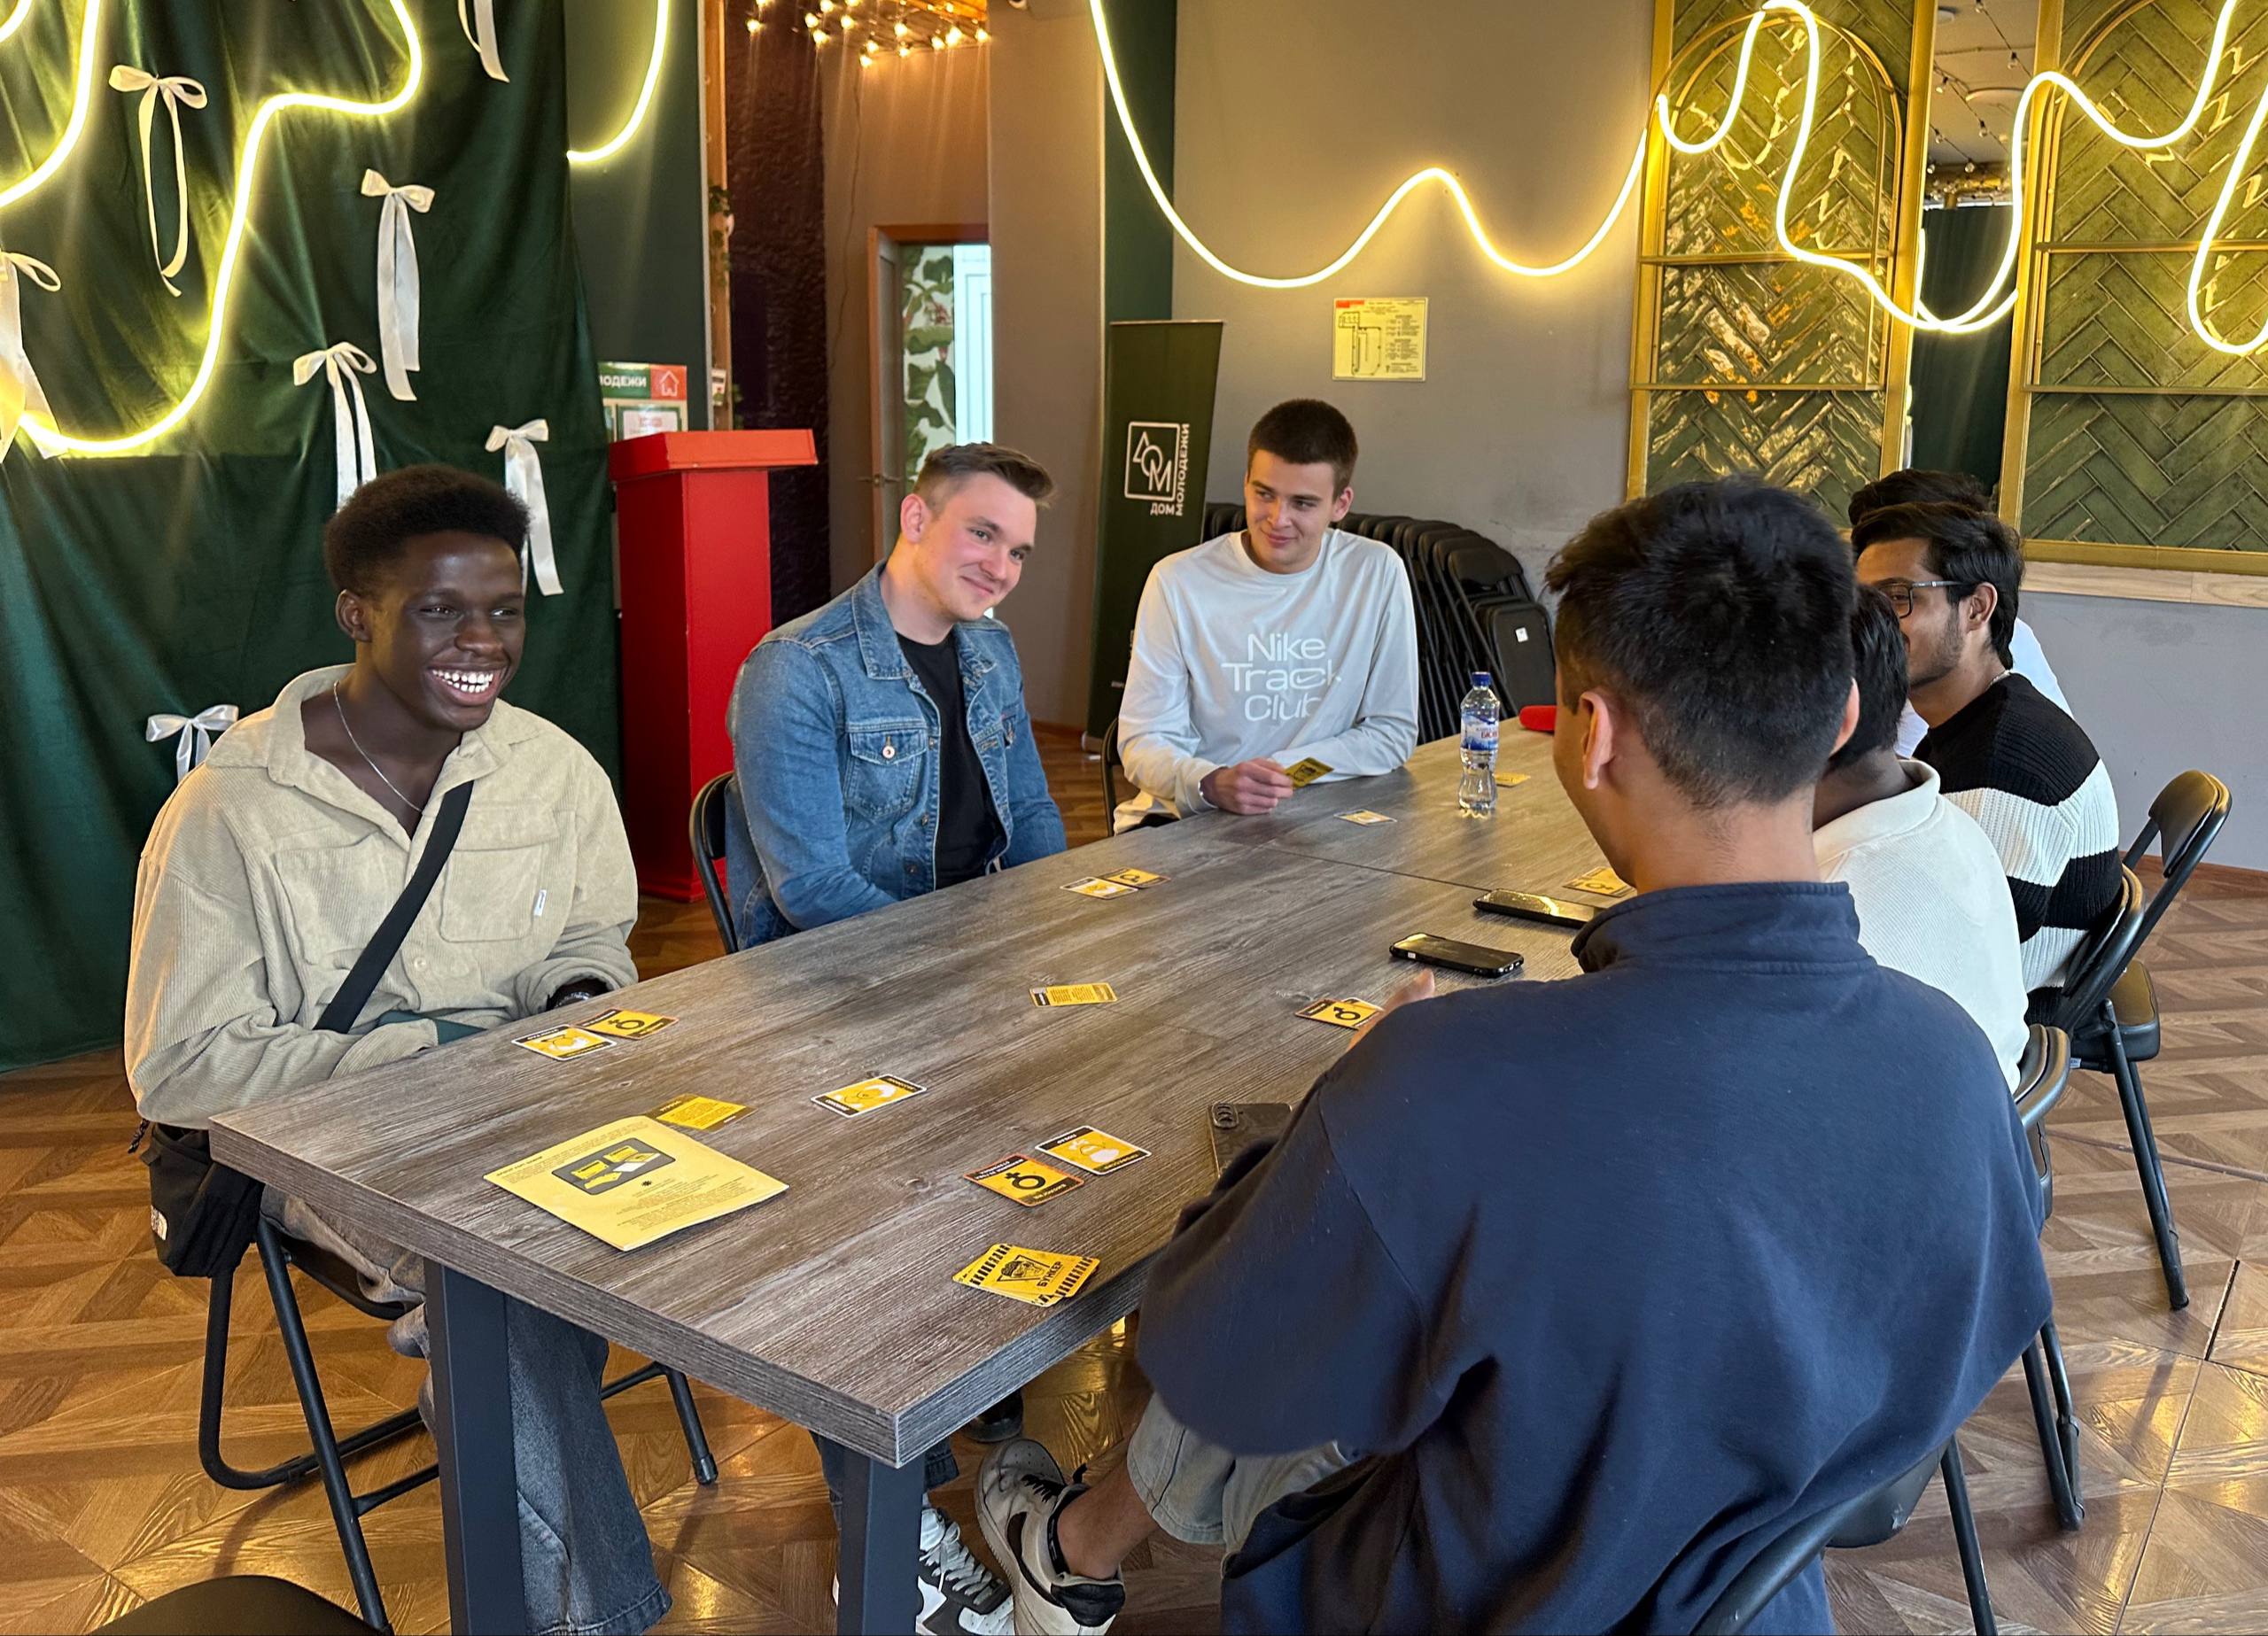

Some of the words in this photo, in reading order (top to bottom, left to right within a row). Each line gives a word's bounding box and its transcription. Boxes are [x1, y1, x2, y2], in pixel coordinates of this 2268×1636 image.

[1176, 423, 1190, 516] МОЛОДЕЖИ
[1150, 502, 1176, 516] ДОМ
[1247, 632, 1326, 663] Nike
[1036, 1260, 1063, 1288] БУНКЕР
